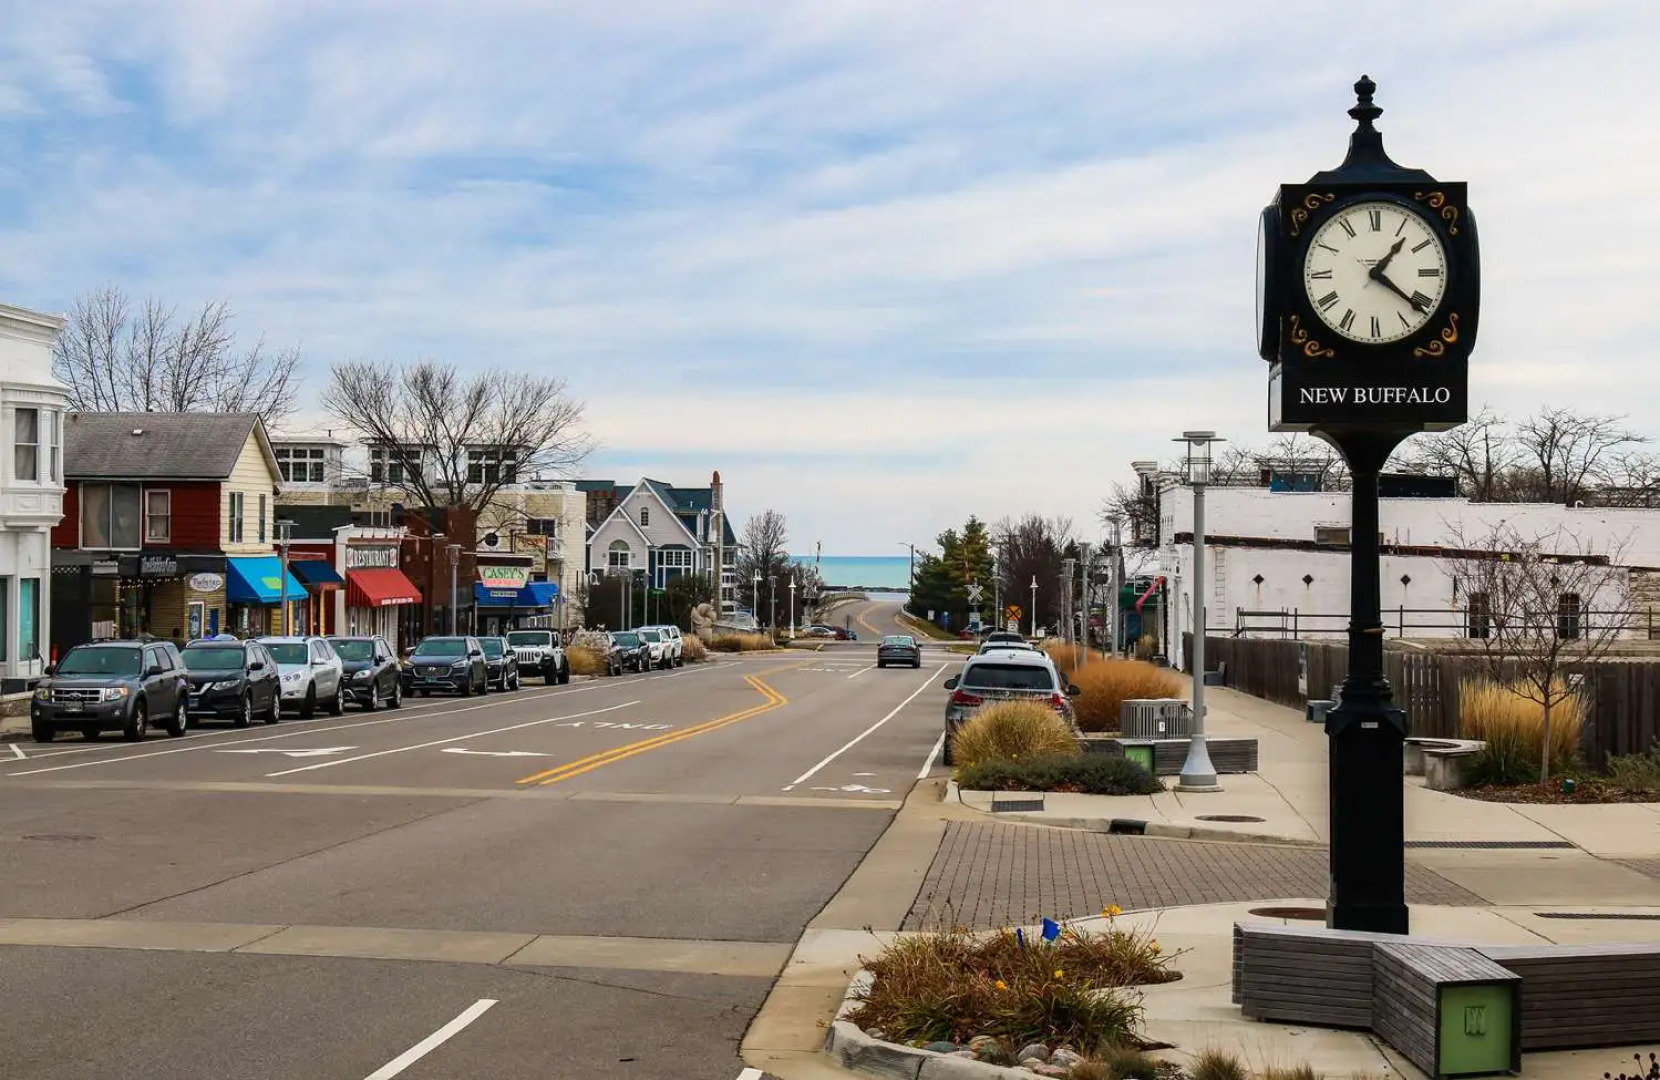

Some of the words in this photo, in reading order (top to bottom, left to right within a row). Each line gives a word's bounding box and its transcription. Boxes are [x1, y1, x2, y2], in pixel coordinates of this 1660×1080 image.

[1299, 387, 1348, 404] NEW
[1354, 387, 1451, 404] BUFFALO
[353, 549, 389, 567] RESTAURANT
[483, 566, 525, 579] CASEY'S
